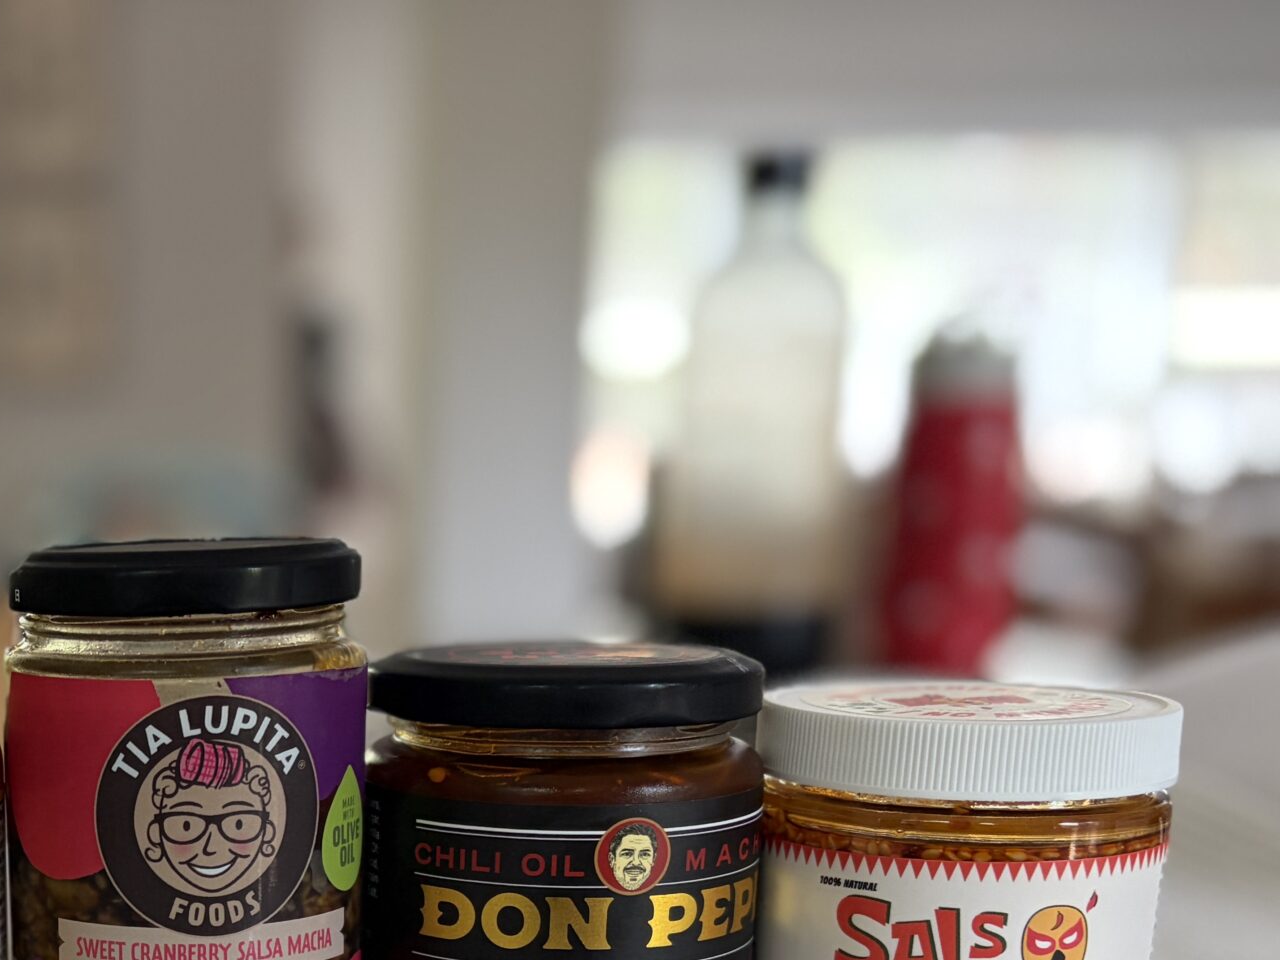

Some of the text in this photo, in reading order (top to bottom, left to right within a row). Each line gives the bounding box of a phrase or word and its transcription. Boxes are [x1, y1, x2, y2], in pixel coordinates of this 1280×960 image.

[111, 704, 300, 780] TIA LUPITA
[333, 818, 360, 847] OLIVE
[340, 842, 355, 867] OIL
[414, 843, 501, 874] CHILI
[521, 853, 585, 877] OIL
[820, 875, 878, 891] 100% NATURAL
[168, 891, 262, 927] FOODS
[419, 884, 615, 951] DON
[76, 937, 126, 960] SWEET
[288, 928, 332, 956] MACHA
